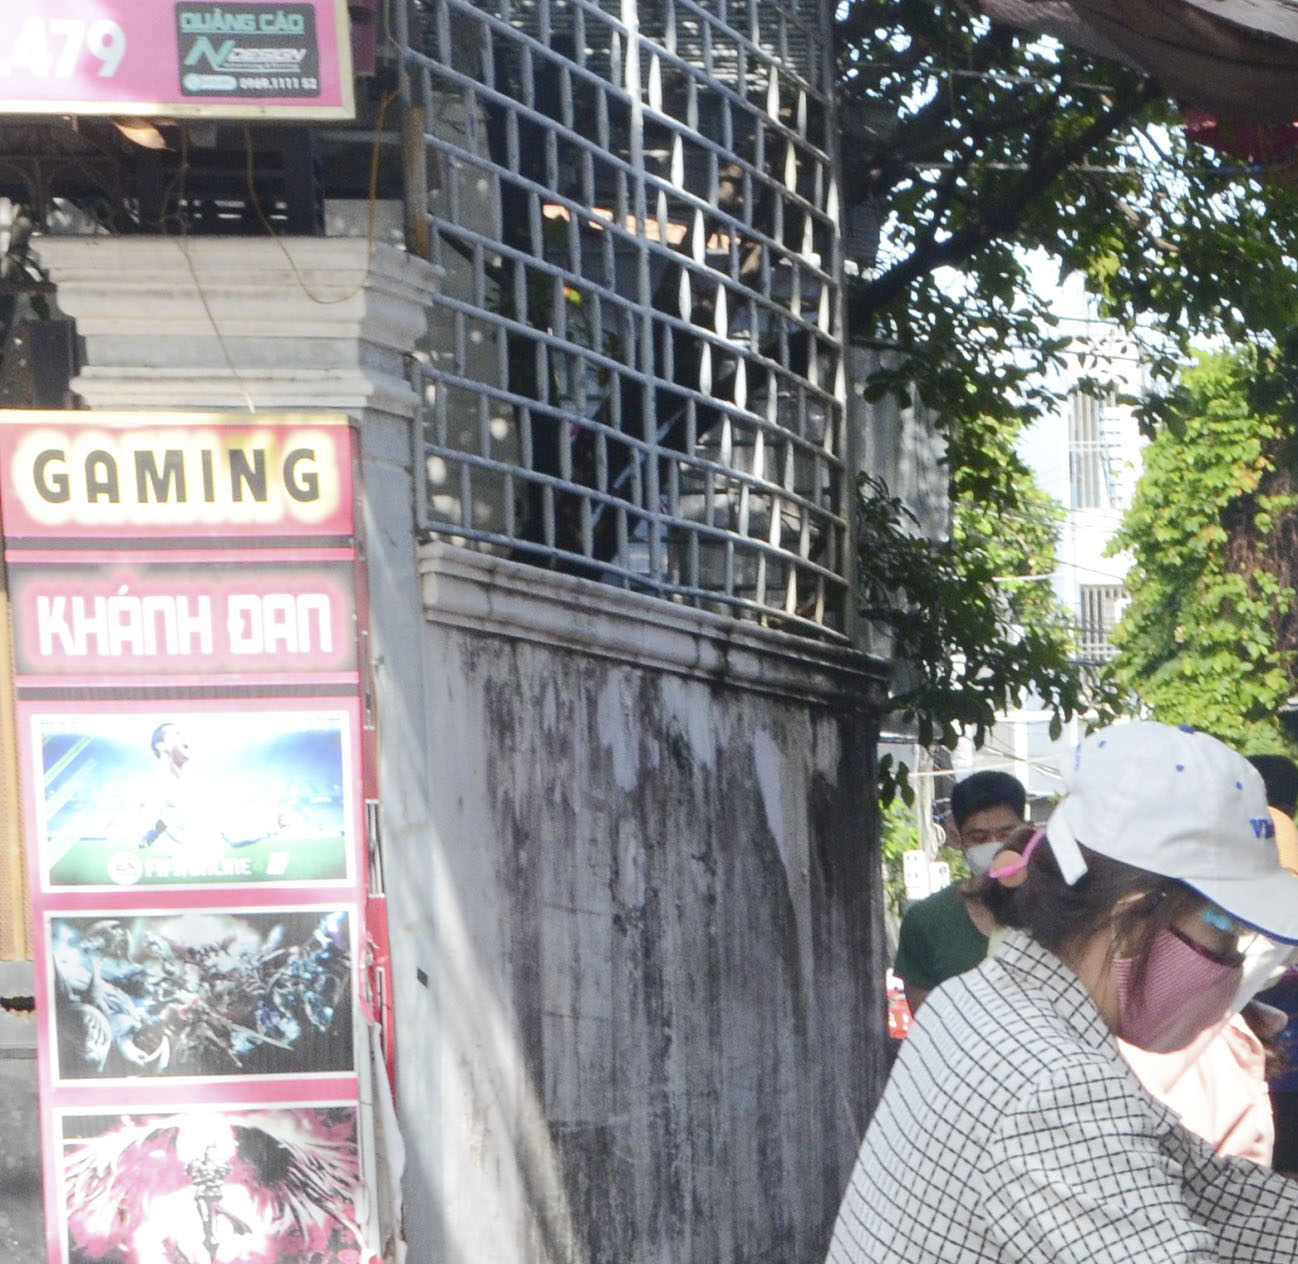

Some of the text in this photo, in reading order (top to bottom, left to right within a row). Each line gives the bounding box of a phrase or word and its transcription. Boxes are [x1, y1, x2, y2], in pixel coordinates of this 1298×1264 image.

[33, 448, 320, 503] GAMING
[36, 584, 333, 656] KHÁNH ĐAN
